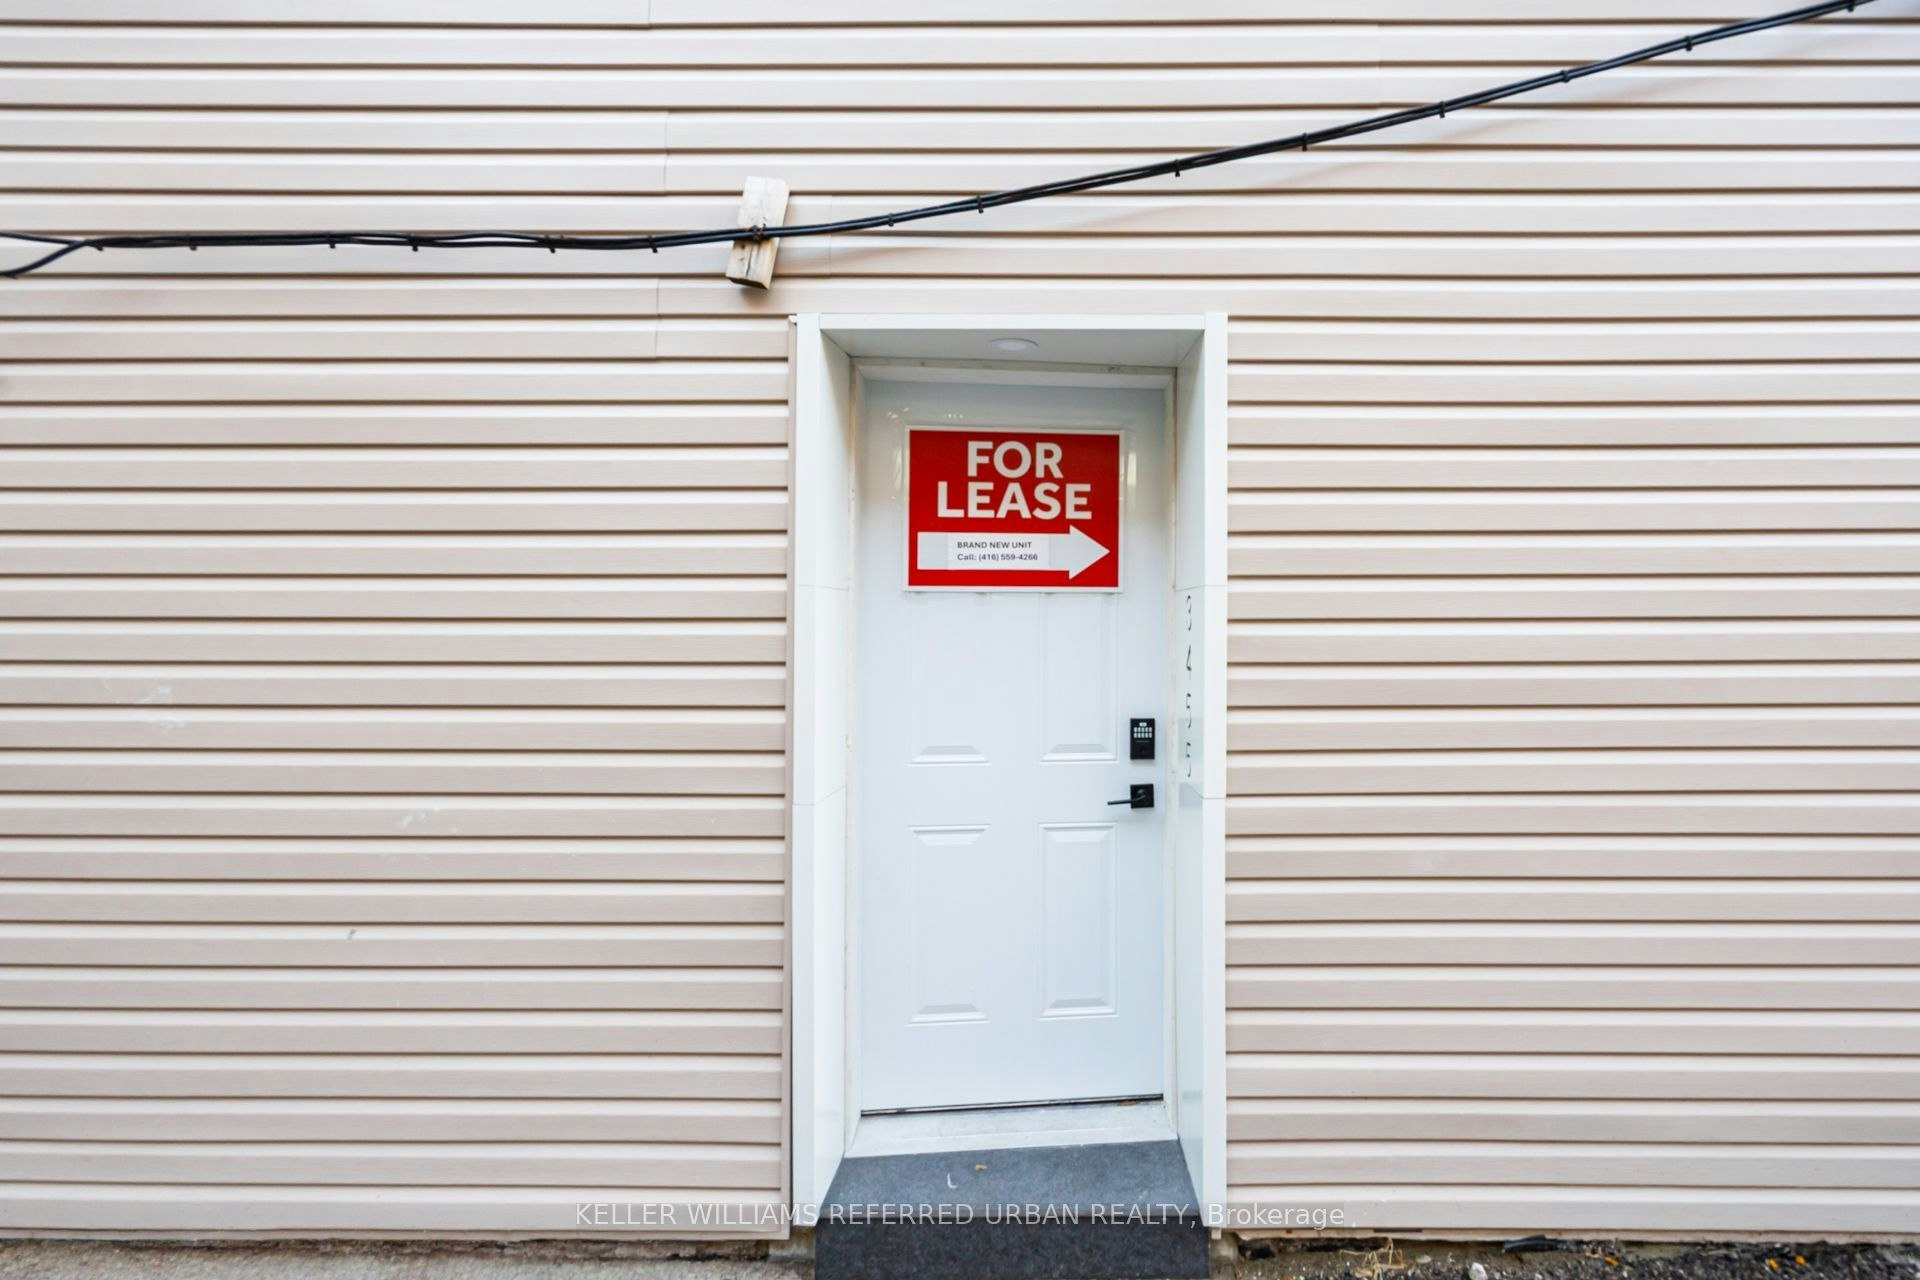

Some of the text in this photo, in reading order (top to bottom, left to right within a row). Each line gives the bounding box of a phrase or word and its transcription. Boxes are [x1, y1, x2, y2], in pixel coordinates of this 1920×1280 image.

[967, 440, 1064, 478] FOR
[937, 481, 1092, 520] LEASE
[957, 541, 1032, 549] BRAND NEW UNIT
[957, 553, 1038, 562] Call: (416) 559-4266
